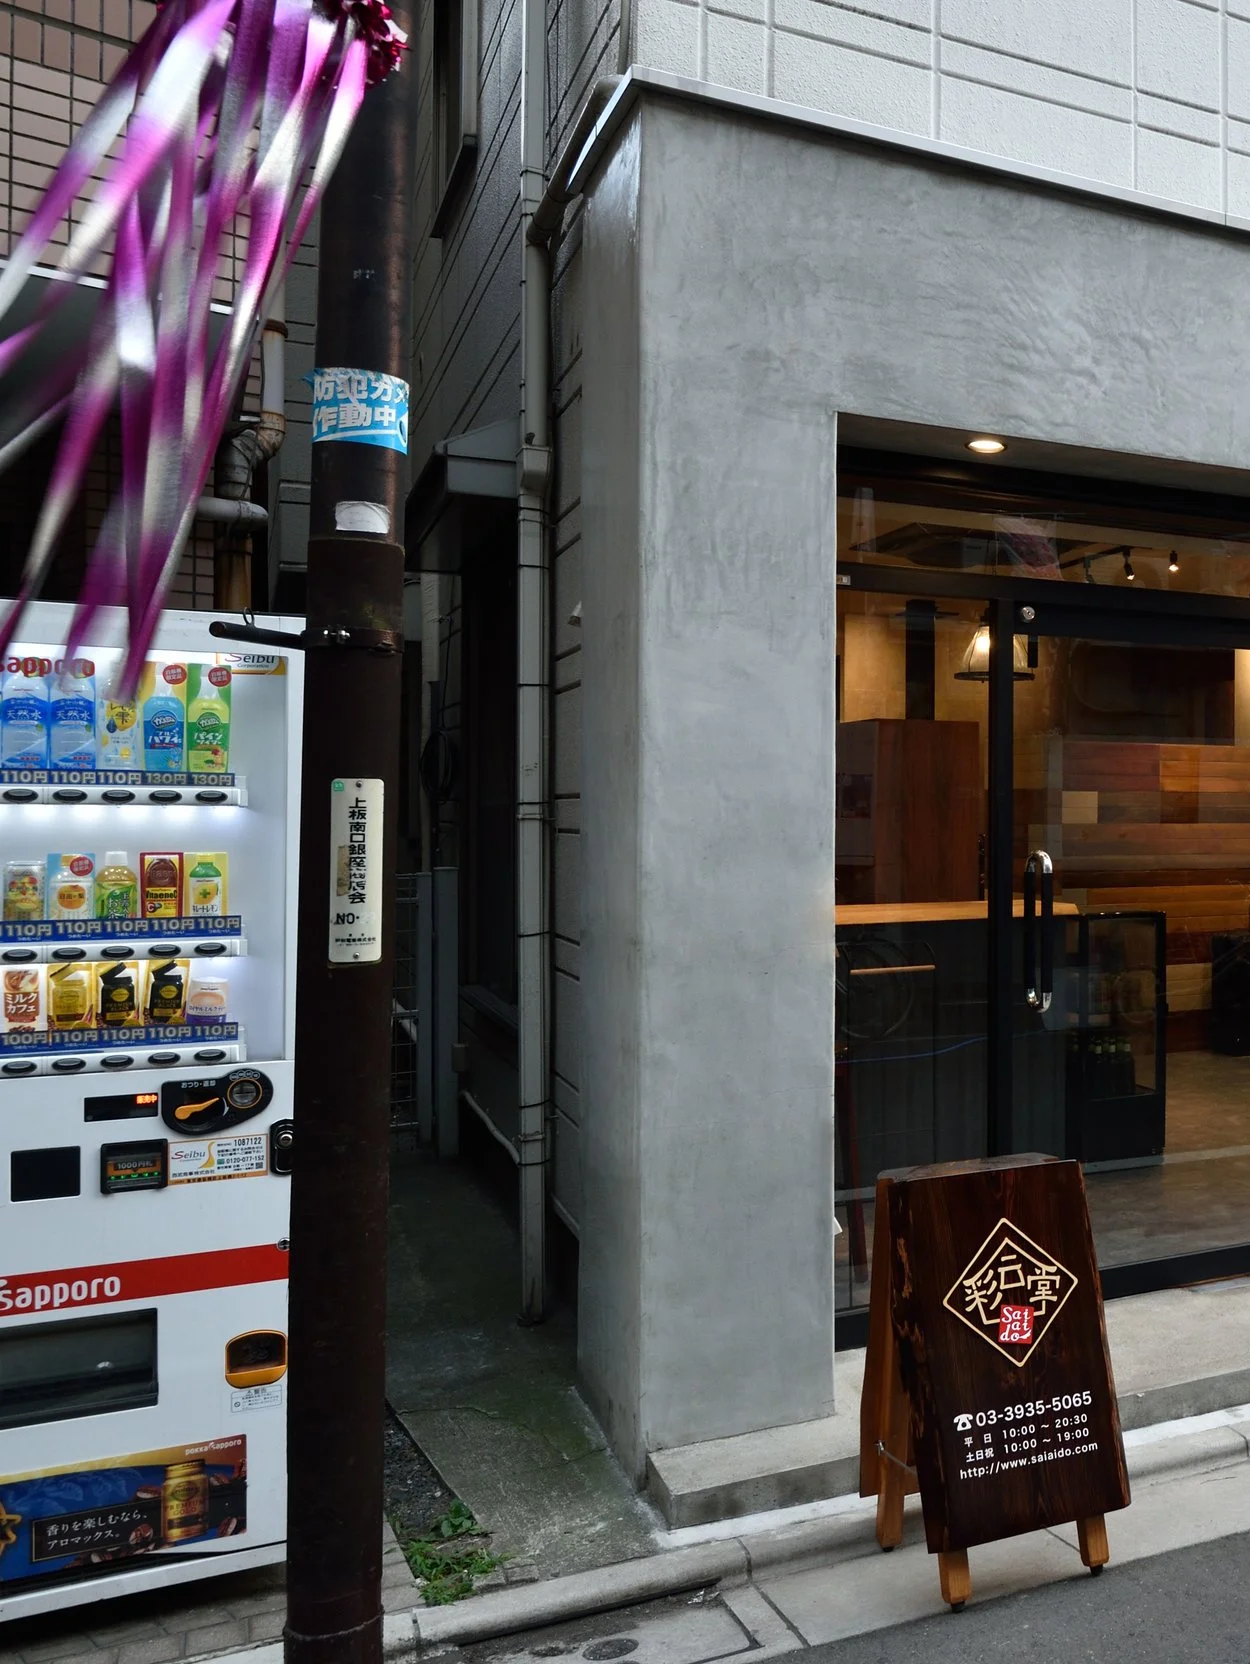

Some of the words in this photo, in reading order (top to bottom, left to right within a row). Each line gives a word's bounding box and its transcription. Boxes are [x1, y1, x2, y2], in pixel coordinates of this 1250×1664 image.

[313, 405, 396, 437] 作動中
[7, 710, 42, 720] 天然水
[55, 711, 91, 720] 天然水
[1, 771, 48, 783] 110円
[51, 771, 97, 783] 110円
[97, 772, 141, 783] 110円
[146, 773, 187, 784] 130円
[192, 774, 232, 785] 130円
[56, 922, 102, 934] 110円
[105, 920, 149, 932] 110円
[151, 919, 194, 930] 110円
[198, 918, 240, 929] 110円
[5, 924, 52, 936] 110円
[6, 993, 37, 1004] ミルク
[7, 1004, 36, 1013] カフェ
[104, 1029, 145, 1040] 110円
[150, 1027, 191, 1038] 110円
[196, 1025, 236, 1035] 110円
[2, 1033, 48, 1045] 100円
[53, 1031, 98, 1042] 110円
[234, 1137, 262, 1146] 1087122
[171, 1150, 205, 1159] Seibu
[1002, 1306, 1031, 1324] Sai
[976, 1391, 1093, 1427] 03-3935-5065
[964, 1437, 974, 1447] 平
[983, 1433, 992, 1443] 日
[1002, 1425, 1036, 1440] 10:00
[1055, 1413, 1088, 1427] 20:30
[966, 1448, 994, 1463] 土日祝
[1004, 1439, 1037, 1454] 10:00
[1057, 1427, 1089, 1442] 19:00
[960, 1442, 1098, 1480] http://www.saiaido.com
